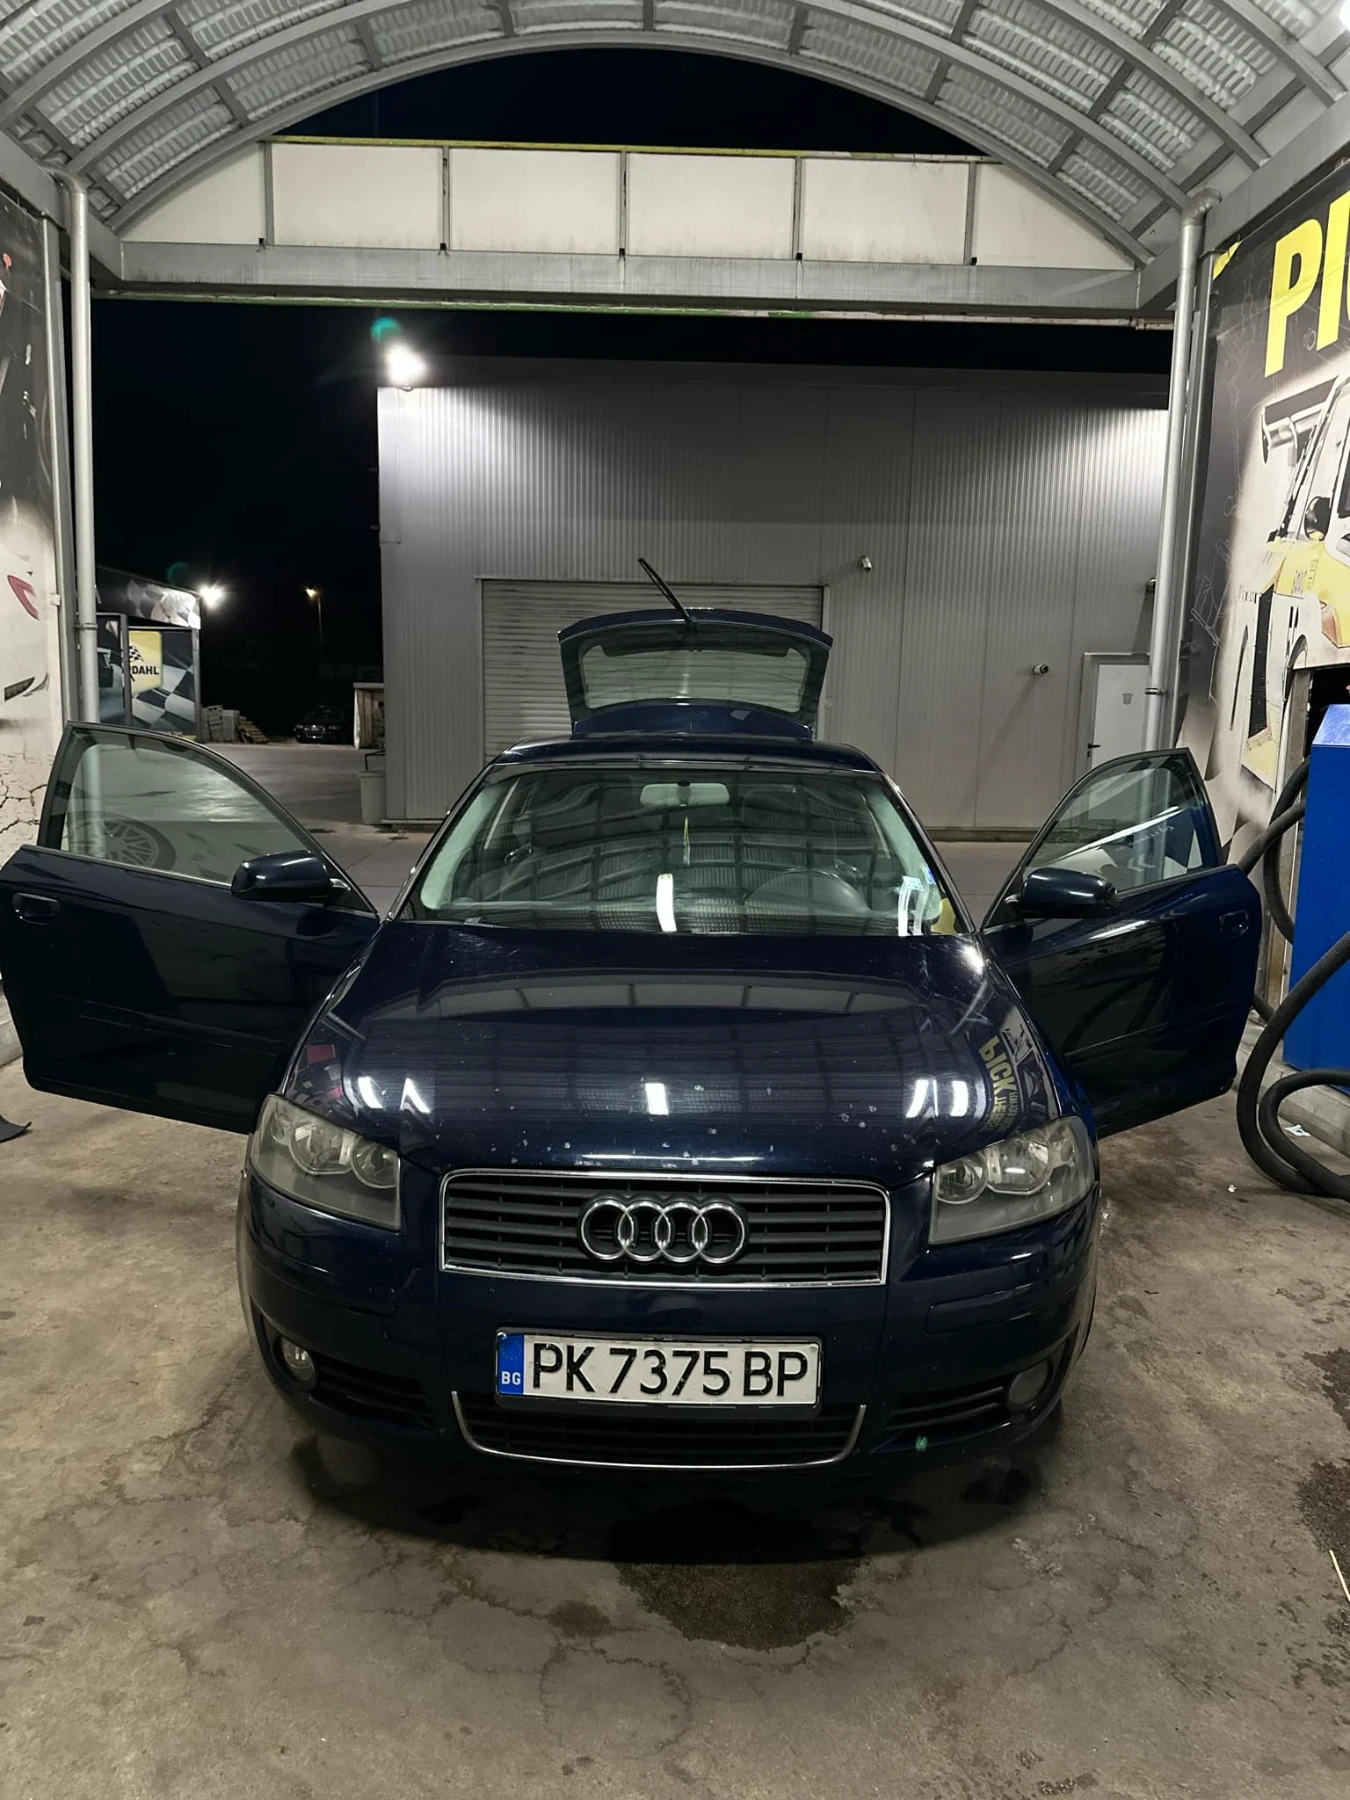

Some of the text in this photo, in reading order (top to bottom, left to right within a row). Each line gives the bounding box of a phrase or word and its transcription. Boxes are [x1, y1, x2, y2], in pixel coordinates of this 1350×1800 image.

[1265, 190, 1350, 378] PI
[130, 666, 160, 675] DAHL
[501, 1371, 521, 1385] BG
[533, 1343, 808, 1396] PK 7375 BP
